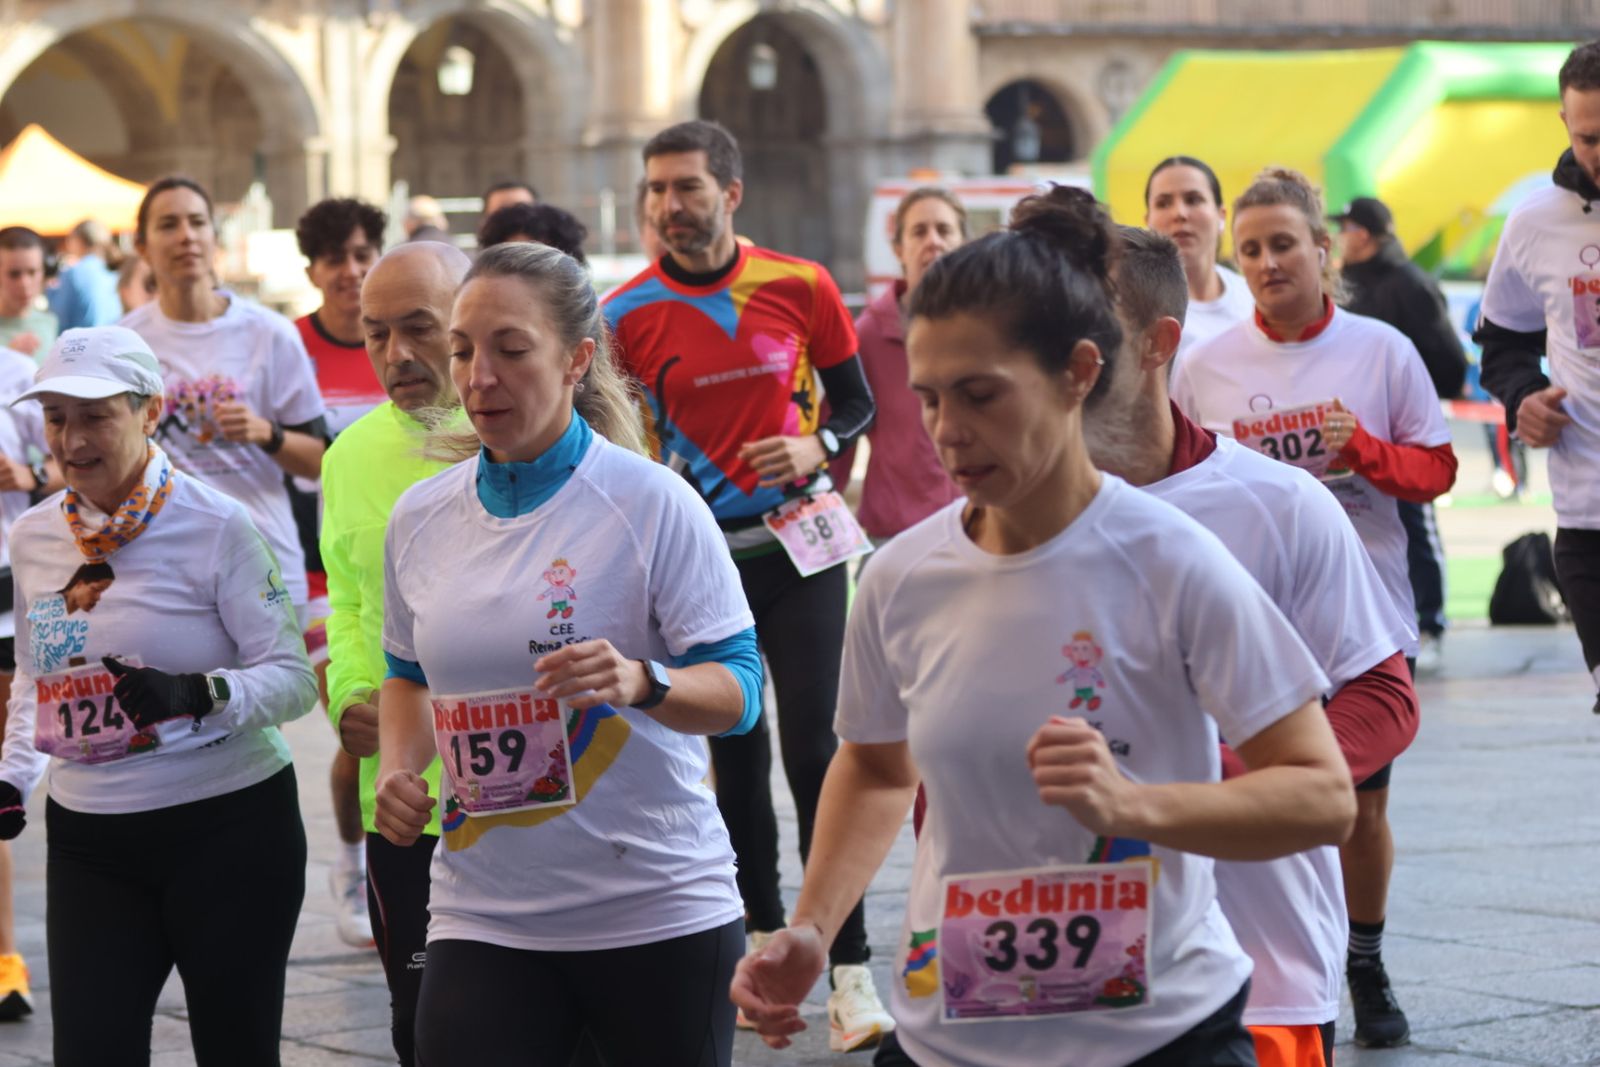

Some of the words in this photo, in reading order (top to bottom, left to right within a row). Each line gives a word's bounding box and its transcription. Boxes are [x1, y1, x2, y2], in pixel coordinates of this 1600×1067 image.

[1232, 405, 1334, 440] beduni
[1260, 428, 1326, 461] 302
[528, 640, 562, 654] Reina
[549, 622, 575, 635] CEE
[36, 673, 122, 705] bedun
[57, 695, 125, 739] 124
[433, 694, 560, 733] bedunia
[450, 729, 527, 778] 159
[944, 874, 1148, 919] bedunia
[984, 915, 1102, 972] 339
